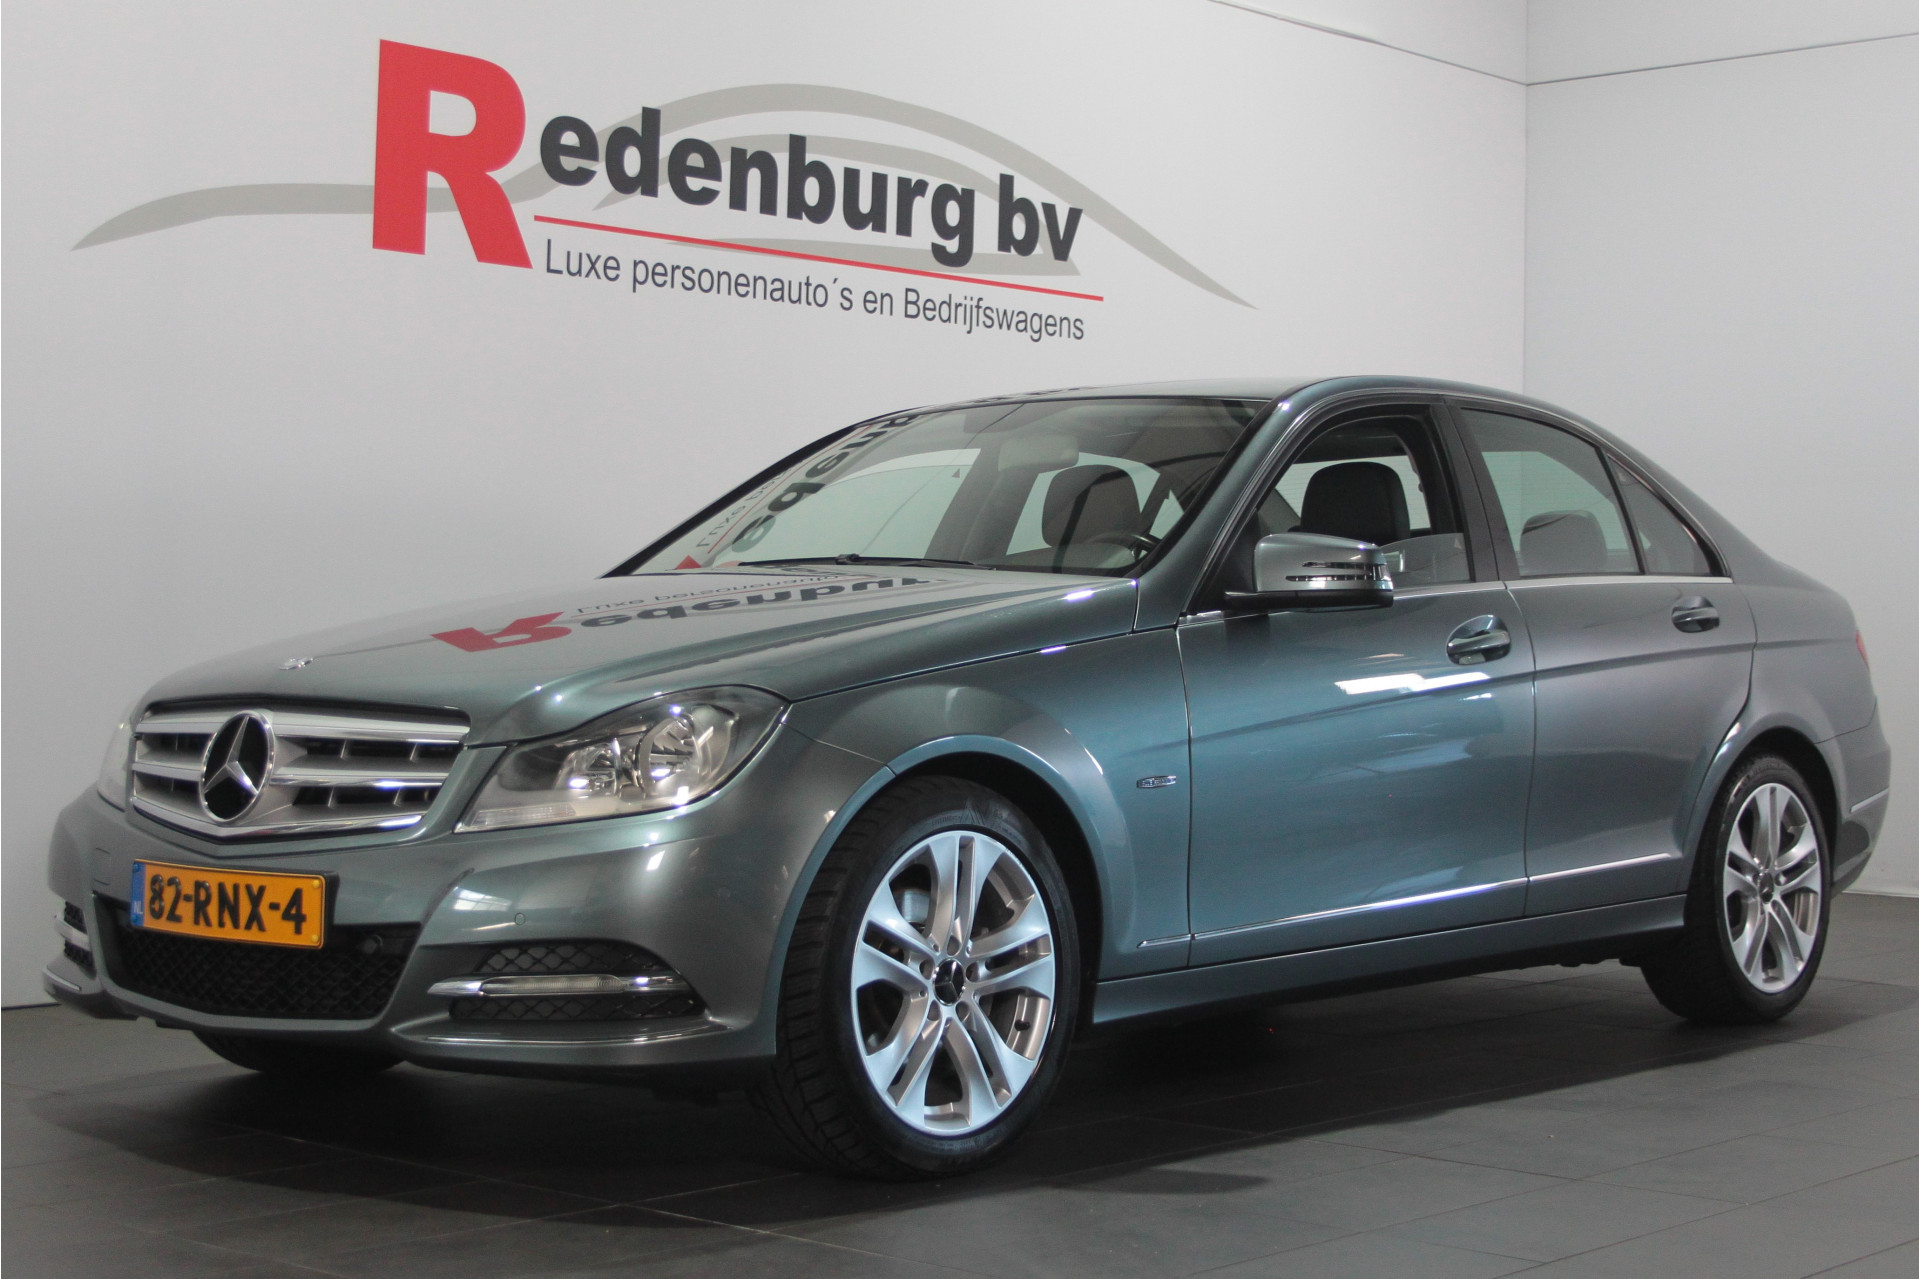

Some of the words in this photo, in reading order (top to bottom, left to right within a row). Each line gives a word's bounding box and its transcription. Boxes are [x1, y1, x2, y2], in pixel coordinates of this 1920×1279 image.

[372, 39, 976, 268] Redenburg
[997, 172, 1084, 262] bv
[545, 238, 622, 282] Luxe
[862, 289, 895, 317] en
[903, 287, 1085, 343] Bedrijfswagens
[133, 900, 144, 915] NL
[149, 873, 308, 936] 82-RNX-4
